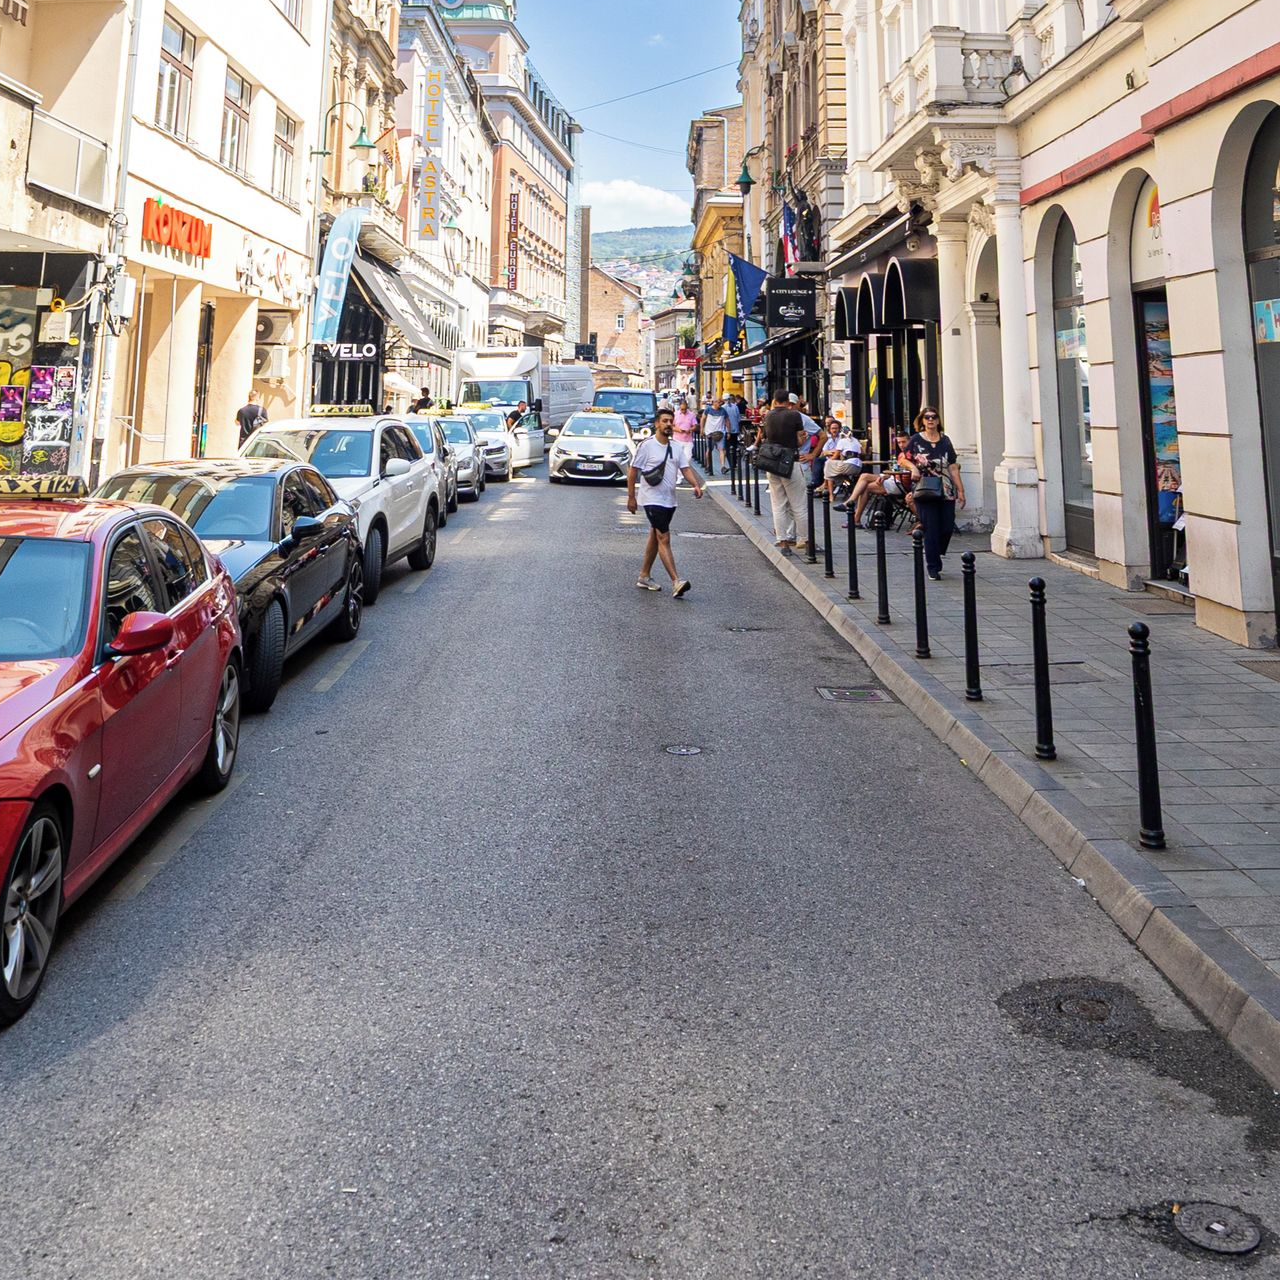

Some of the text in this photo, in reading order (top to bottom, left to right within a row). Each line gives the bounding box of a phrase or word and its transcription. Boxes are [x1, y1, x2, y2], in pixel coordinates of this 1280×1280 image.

[420, 70, 442, 237] HOTEL ASTRA
[142, 197, 213, 259] KONZUM
[508, 194, 518, 290] HOTEL EUROPE
[317, 237, 354, 322] VELO
[327, 343, 377, 358] VELO
